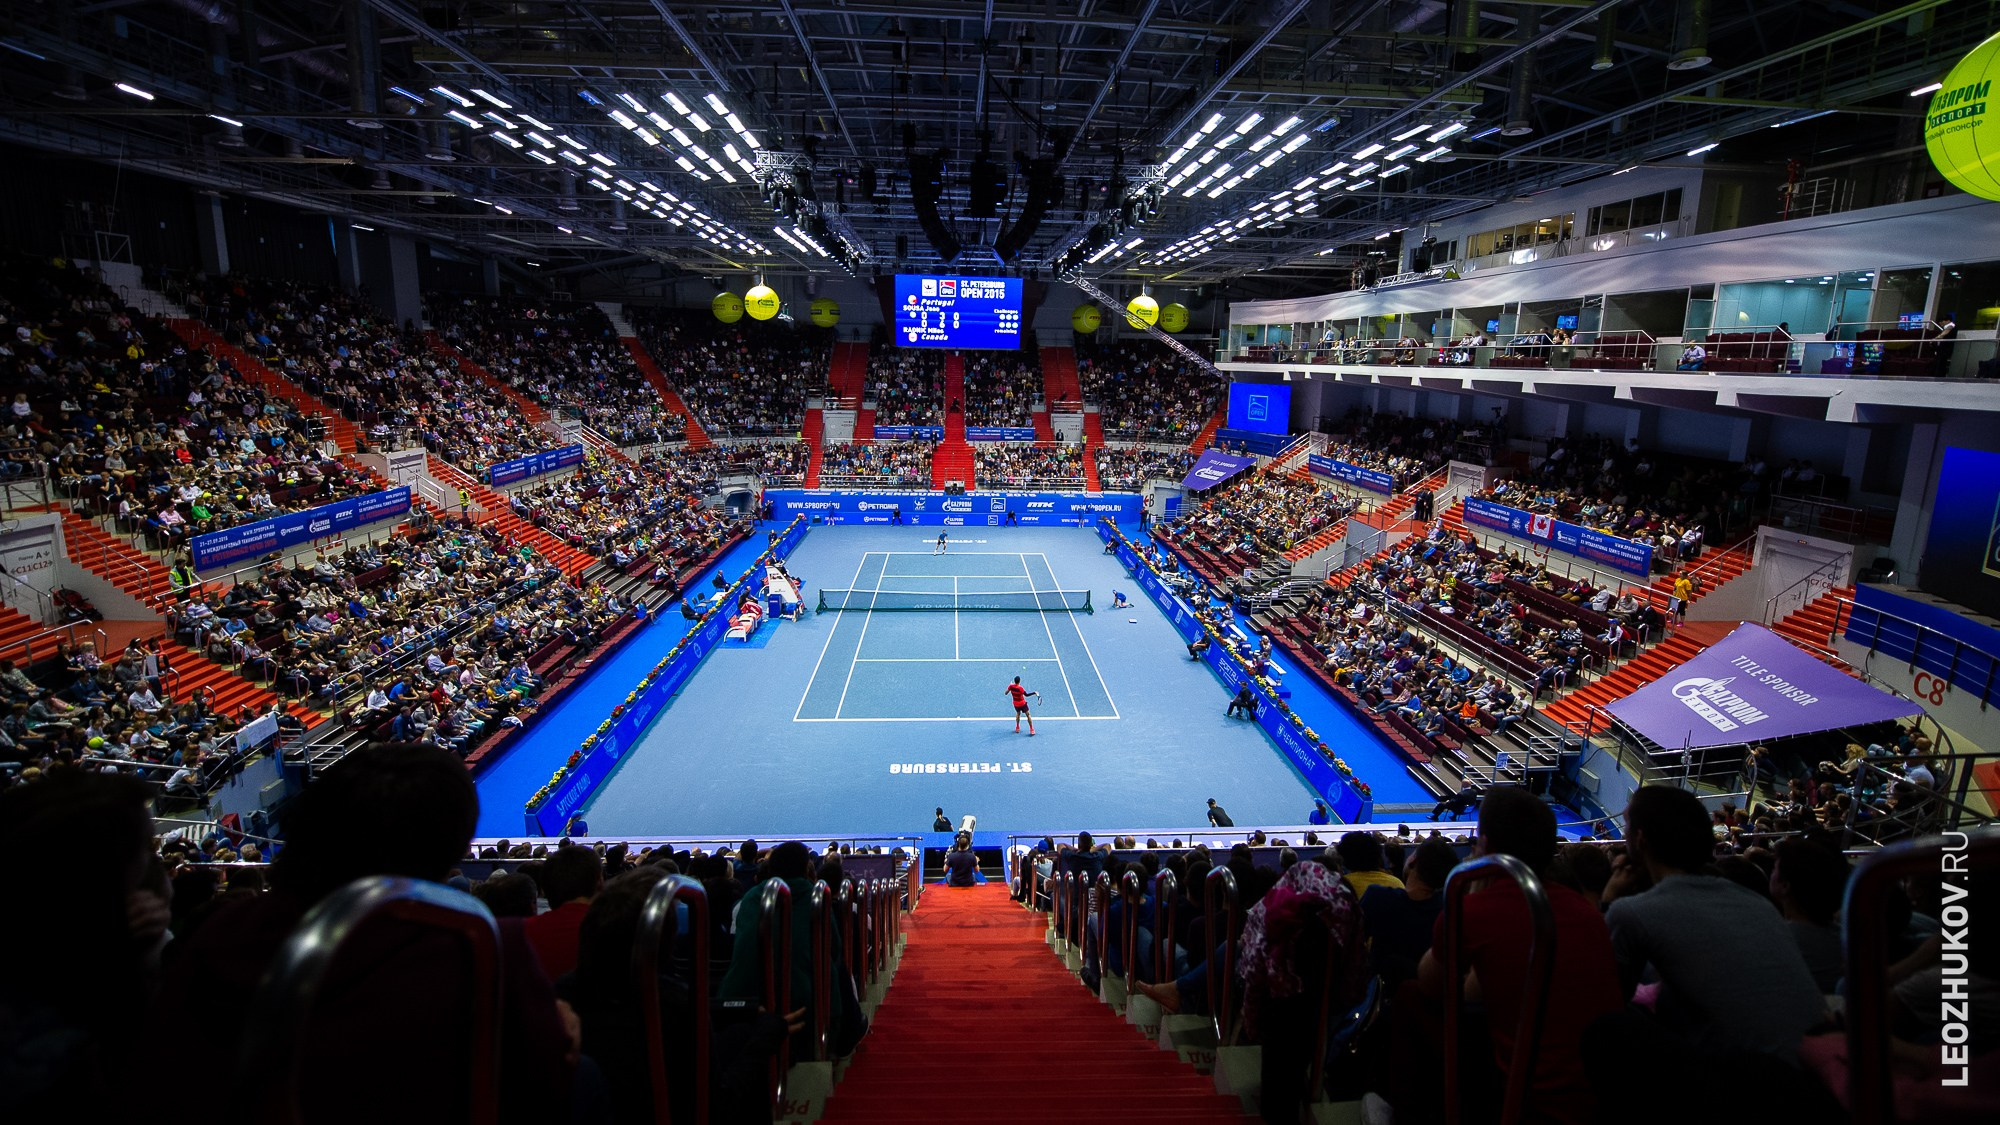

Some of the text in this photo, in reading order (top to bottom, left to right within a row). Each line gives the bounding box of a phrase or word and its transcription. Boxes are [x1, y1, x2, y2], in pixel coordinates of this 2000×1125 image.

[1945, 119, 1983, 135] СПОНСОР
[970, 280, 1005, 289] PETERSBURG
[961, 288, 1006, 299] OPEN 2015
[921, 298, 955, 307] Portugal
[921, 311, 960, 321] 0 3 0
[921, 320, 960, 329] 0 6 0
[921, 333, 949, 341] Canada
[786, 501, 840, 510] WWW.SPBOPENRU
[951, 500, 972, 508] GAZPROM
[1148, 493, 1155, 508] B
[1731, 655, 1819, 706] TITLE SPONSOR
[1912, 671, 1946, 707] C8
[1706, 685, 1770, 725] GAZPROM
[1685, 697, 1735, 729] EXPORT
[1282, 730, 1316, 771] ЧЕМПИОНАТ
[889, 762, 1033, 774] ST. PETERSBURG
